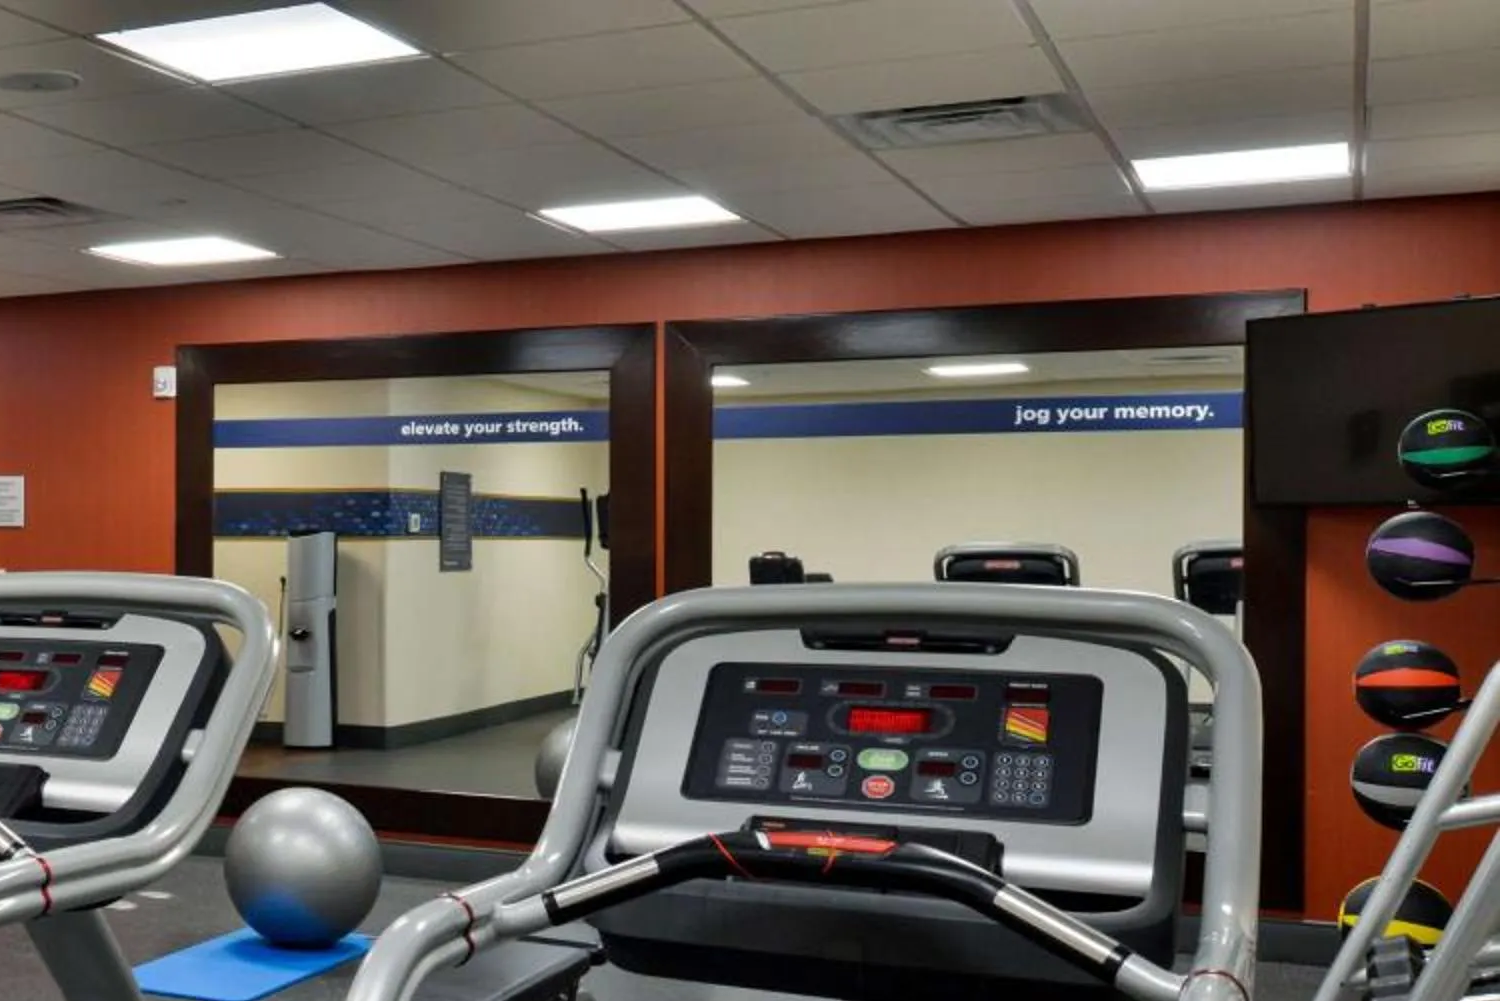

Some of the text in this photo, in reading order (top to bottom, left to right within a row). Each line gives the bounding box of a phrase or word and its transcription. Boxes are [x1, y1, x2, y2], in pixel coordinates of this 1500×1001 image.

[1014, 404, 1215, 425] jog your memory.
[401, 417, 585, 437] elevate your strength.
